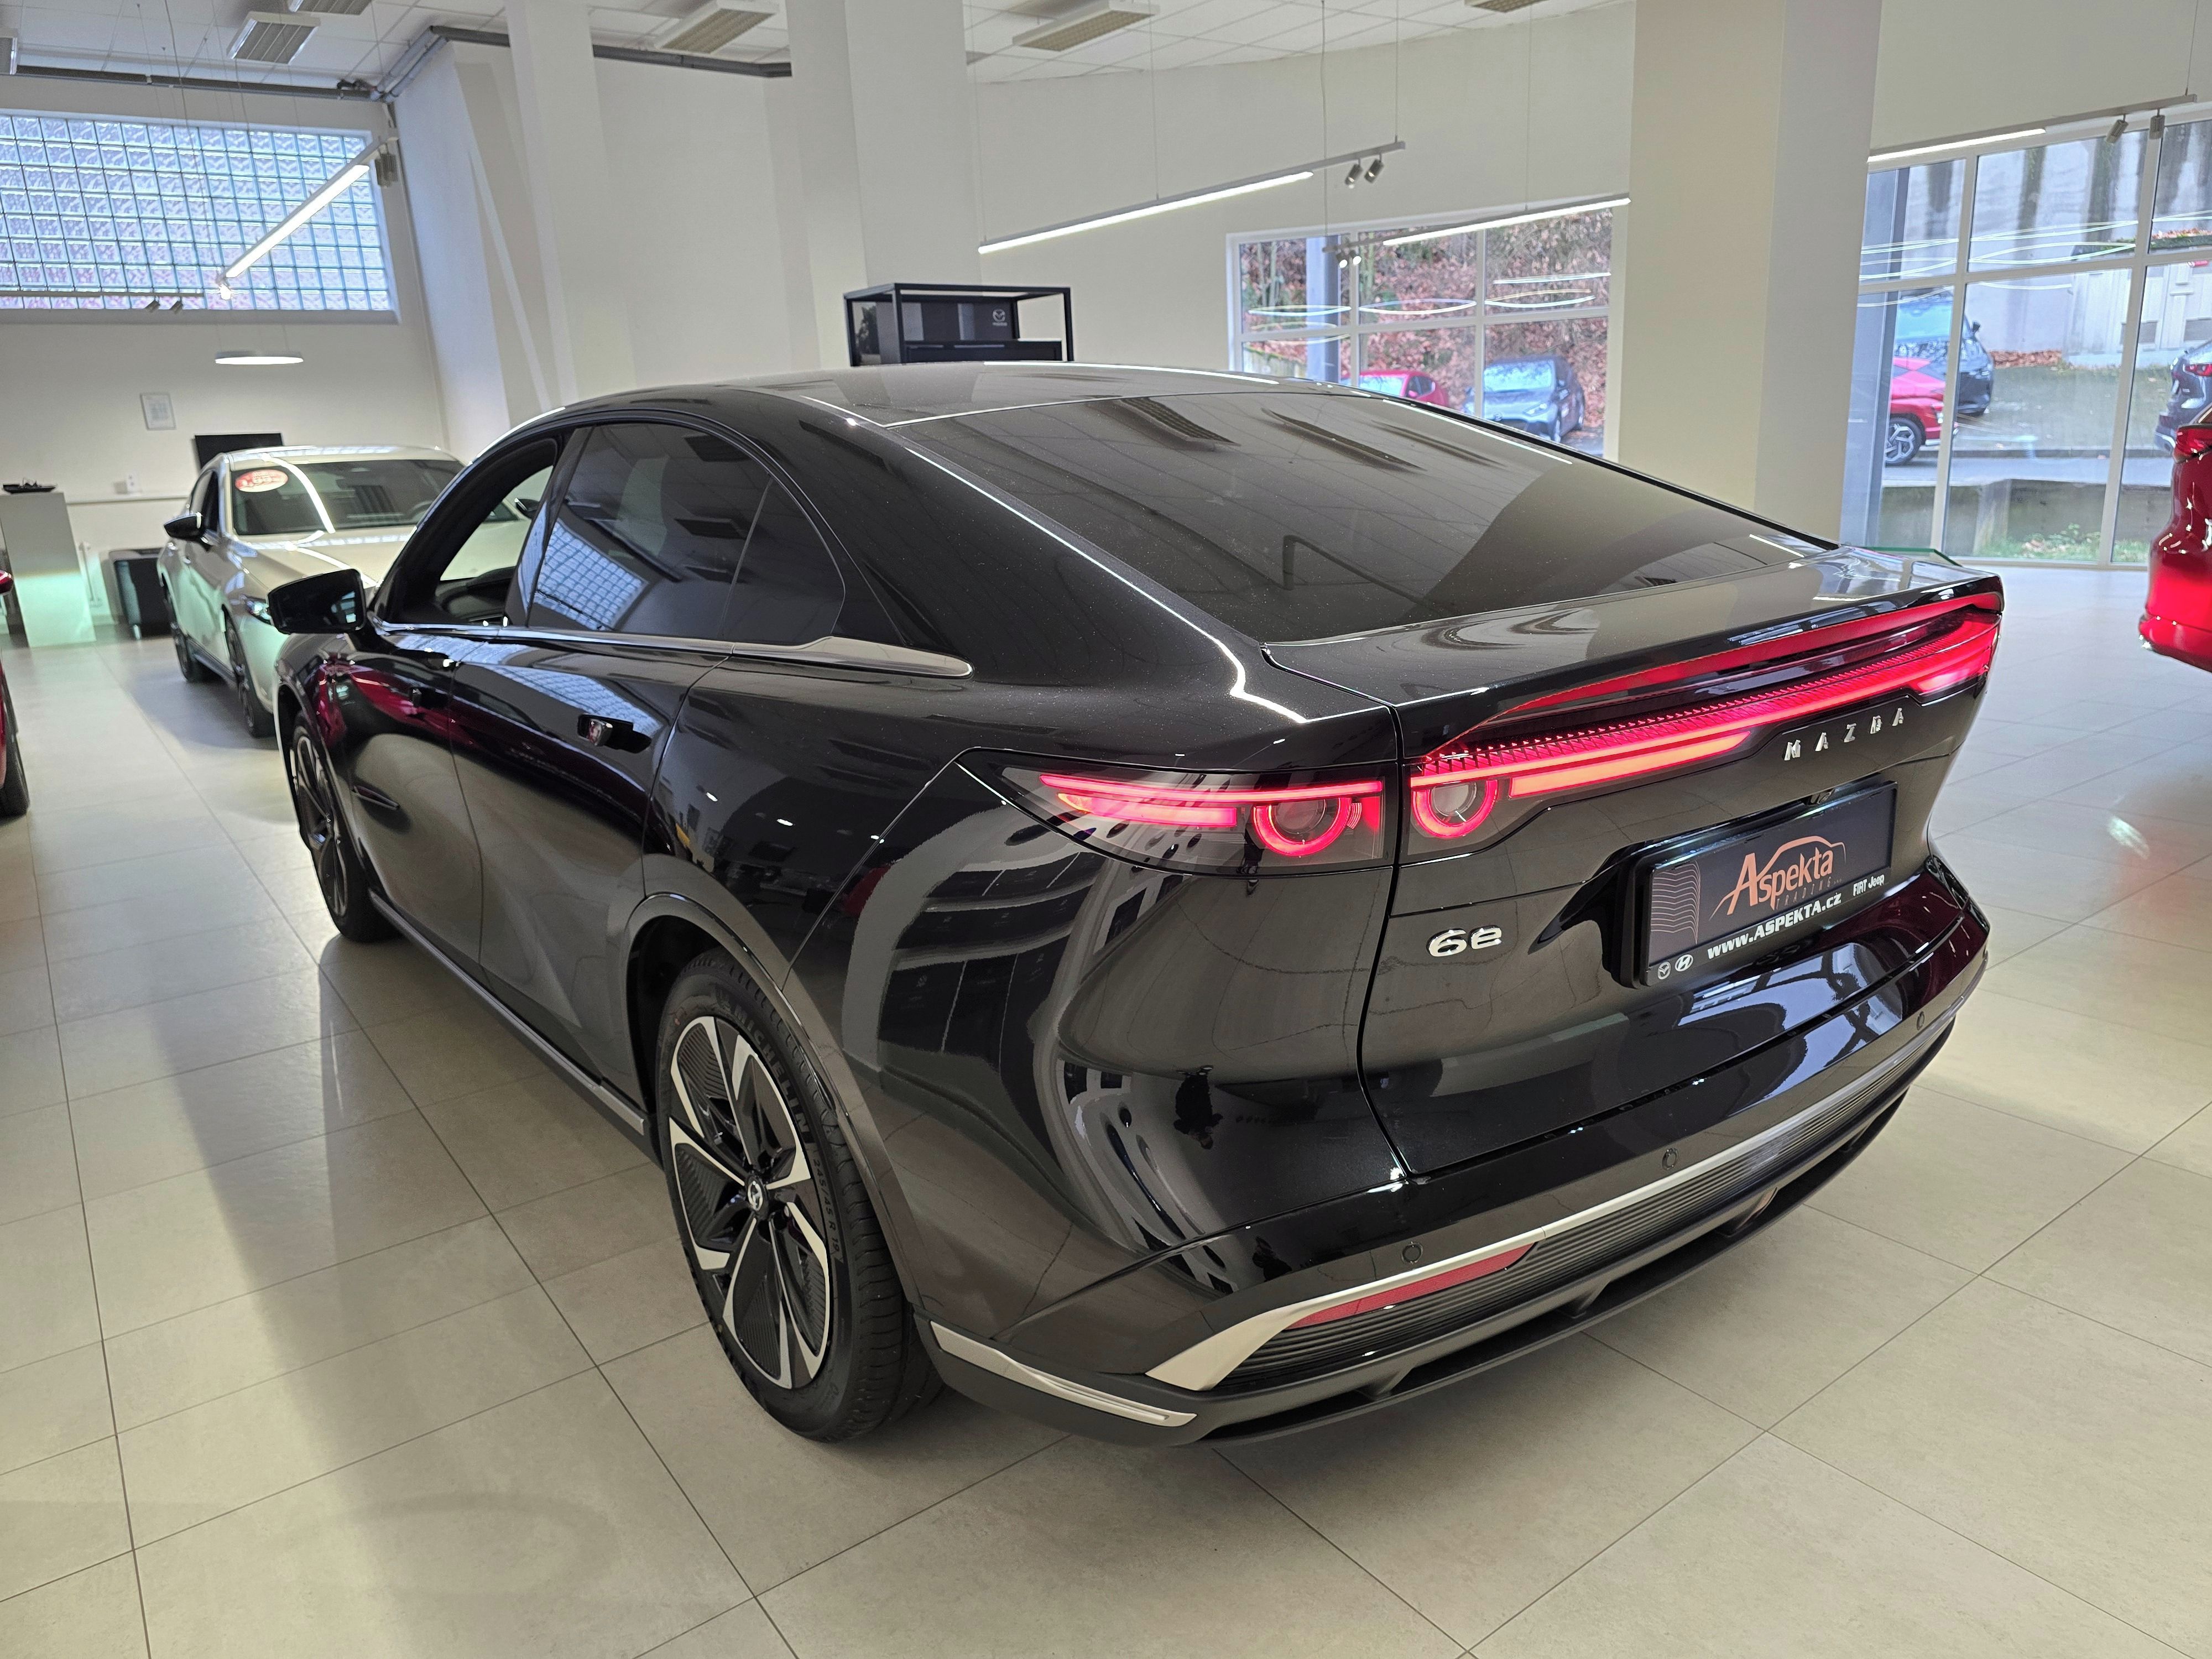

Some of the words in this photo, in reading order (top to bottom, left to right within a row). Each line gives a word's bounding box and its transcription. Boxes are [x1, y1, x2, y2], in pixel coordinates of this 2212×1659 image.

[1783, 708, 1904, 761] MAZDA
[1726, 847, 1833, 915] Aspekta
[1776, 876, 1832, 910] TRADING
[1853, 879, 1867, 896] FIAT
[1868, 874, 1885, 889] Jeep
[1427, 926, 1503, 957] 6e
[734, 1004, 811, 1133] MICHELIN
[812, 1158, 833, 1216] 245/45
[831, 1237, 840, 1251] 19
